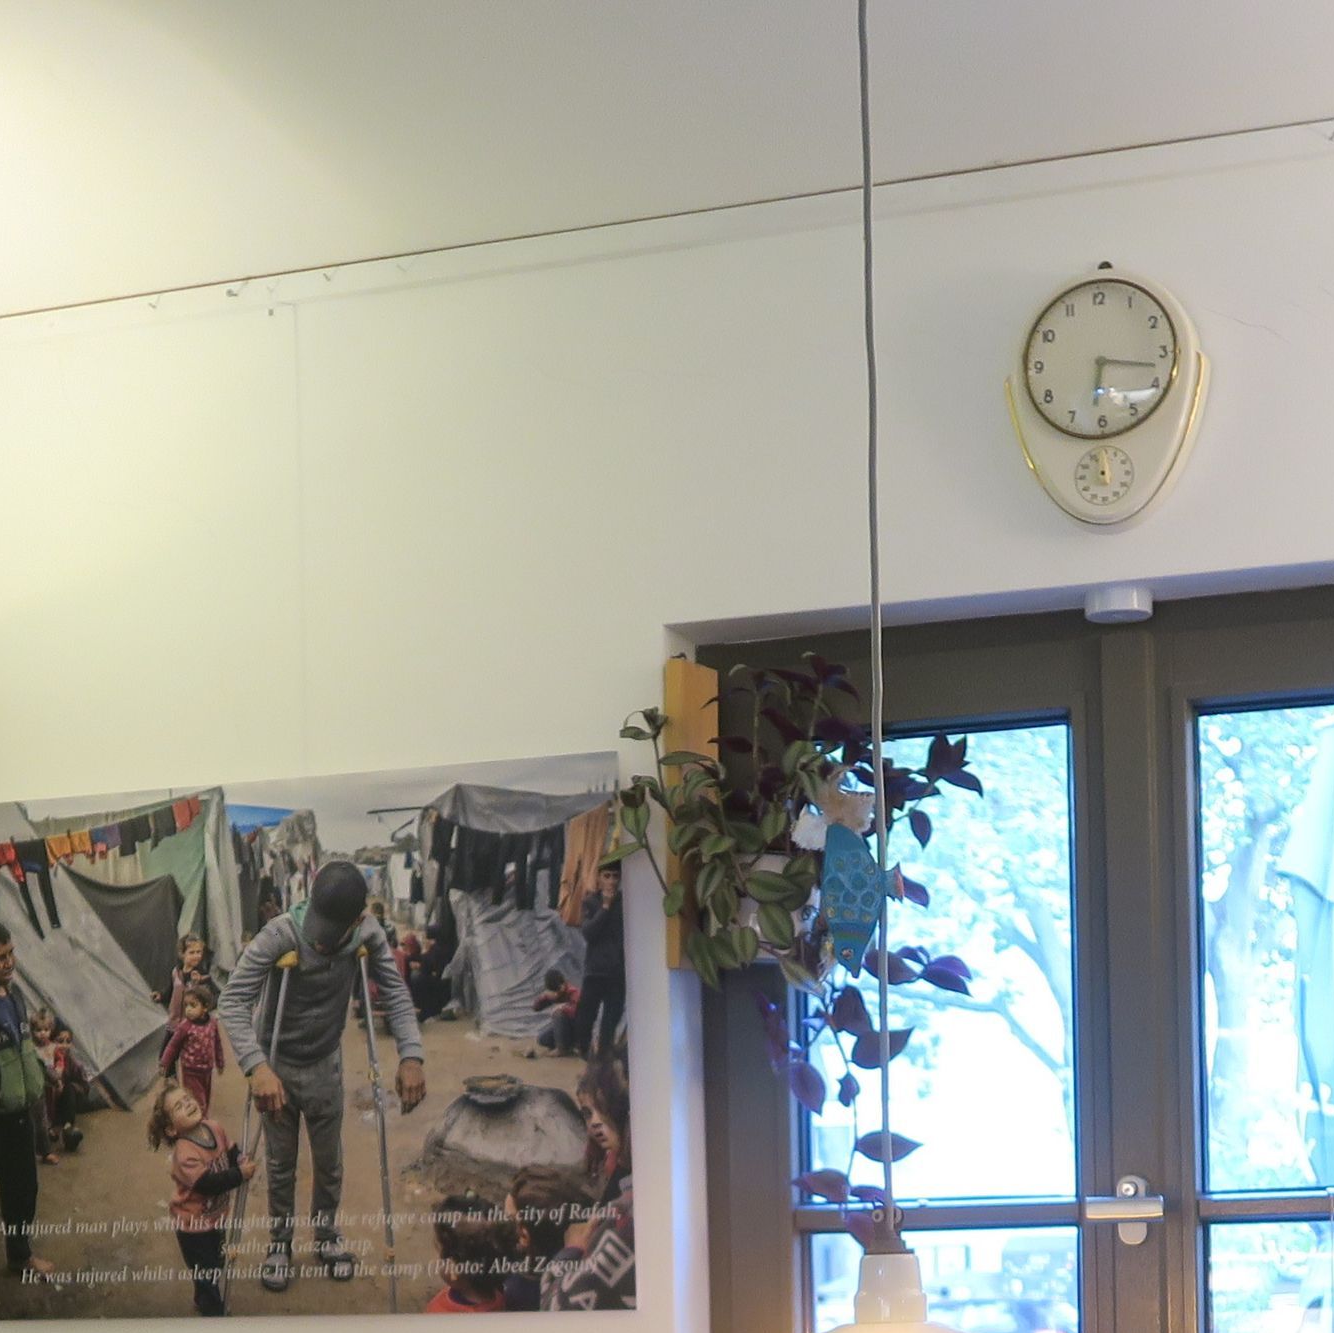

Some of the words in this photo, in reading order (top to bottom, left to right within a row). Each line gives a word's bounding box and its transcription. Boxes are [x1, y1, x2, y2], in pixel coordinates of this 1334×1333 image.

[1093, 292, 1105, 305] 12
[1127, 296, 1133, 308] 1
[1064, 304, 1075, 317] 11
[1147, 316, 1158, 329] 2
[1042, 330, 1055, 343] 10
[1159, 345, 1168, 358] 3
[1034, 361, 1044, 374] 9
[1151, 376, 1160, 389] 4
[1043, 390, 1053, 403] 8
[1129, 402, 1138, 415] 5
[1068, 410, 1077, 423] 7
[1097, 415, 1108, 428] 6
[21, 1216, 72, 1238] injured
[75, 1220, 108, 1234] man
[112, 1217, 149, 1238] plays
[153, 1214, 184, 1231] with
[189, 1213, 211, 1230] his
[214, 1211, 282, 1233] daughter
[285, 1210, 329, 1228] inside
[334, 1210, 356, 1227] the
[361, 1208, 416, 1231] refugee
[419, 1209, 462, 1229] camp
[467, 1206, 482, 1223] in
[487, 1204, 512, 1222] the
[516, 1203, 545, 1225] city
[549, 1202, 568, 1225] of
[569, 1201, 622, 1222] Rafah,
[220, 1238, 286, 1256] southern
[290, 1236, 331, 1253] Gaza
[334, 1235, 373, 1256] Strip.
[20, 1268, 41, 1285] He
[44, 1270, 73, 1285] was
[76, 1265, 127, 1289] injured
[132, 1265, 176, 1282] whilst
[178, 1264, 222, 1285] asleep
[226, 1263, 271, 1280] inside
[274, 1262, 296, 1279] his
[300, 1262, 329, 1278] tent
[354, 1260, 377, 1276] the
[381, 1261, 423, 1281] camp
[427, 1256, 484, 1278] (Photo:
[489, 1255, 529, 1274] Abed
